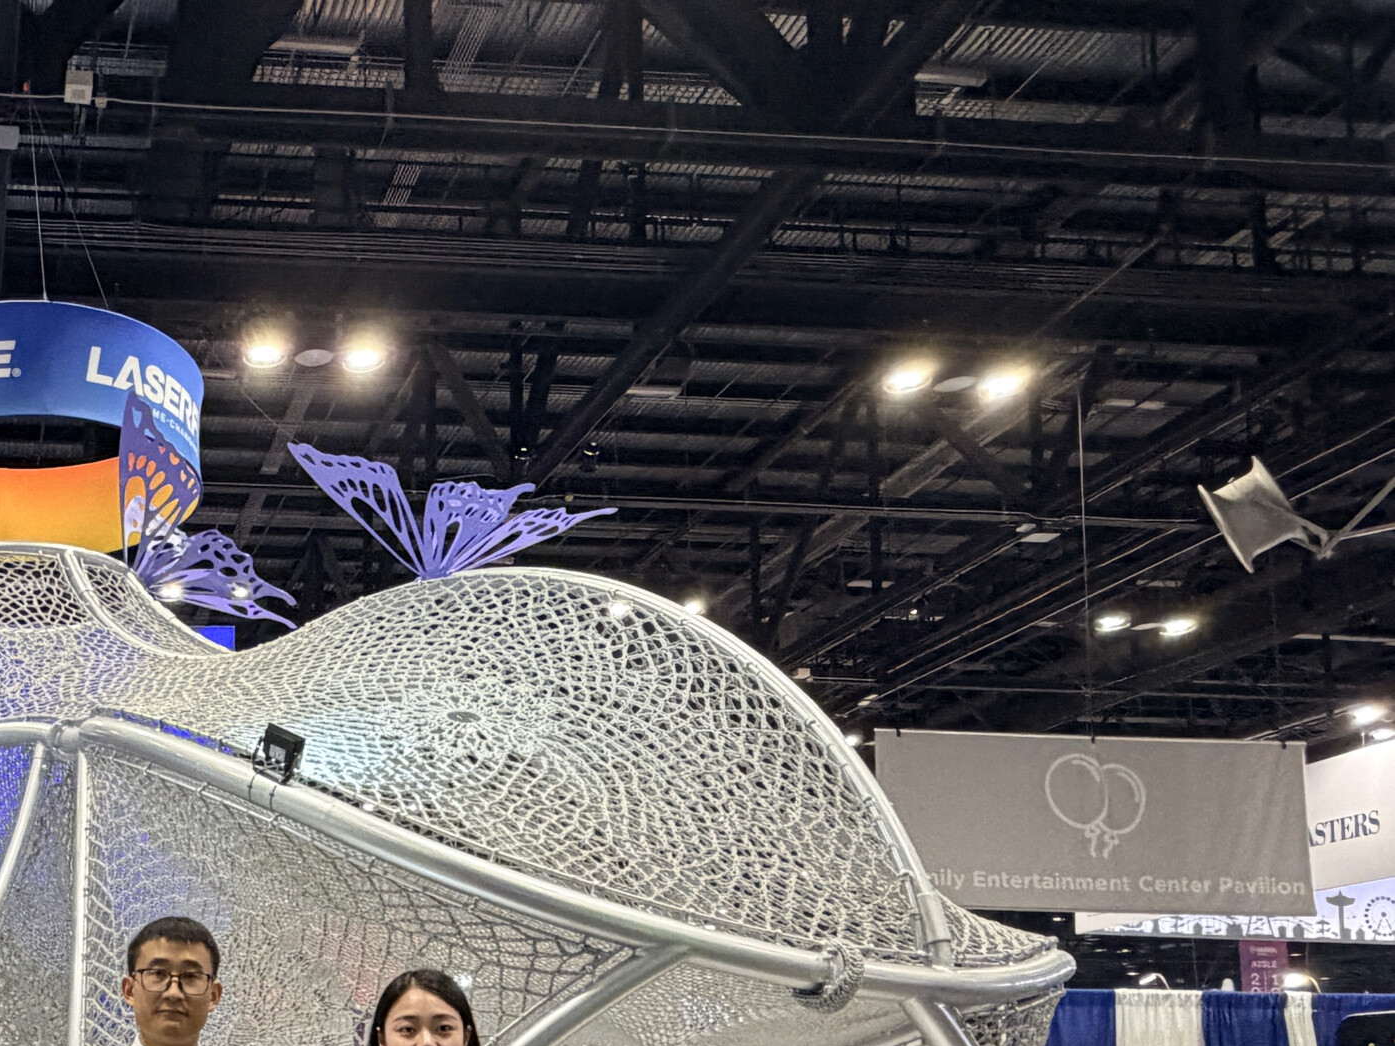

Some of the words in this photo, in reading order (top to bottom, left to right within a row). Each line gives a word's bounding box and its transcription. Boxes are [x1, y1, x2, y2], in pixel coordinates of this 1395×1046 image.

[972, 869, 1131, 892] Entertainment
[1138, 874, 1211, 894] Center
[1218, 875, 1306, 897] Pavilion
